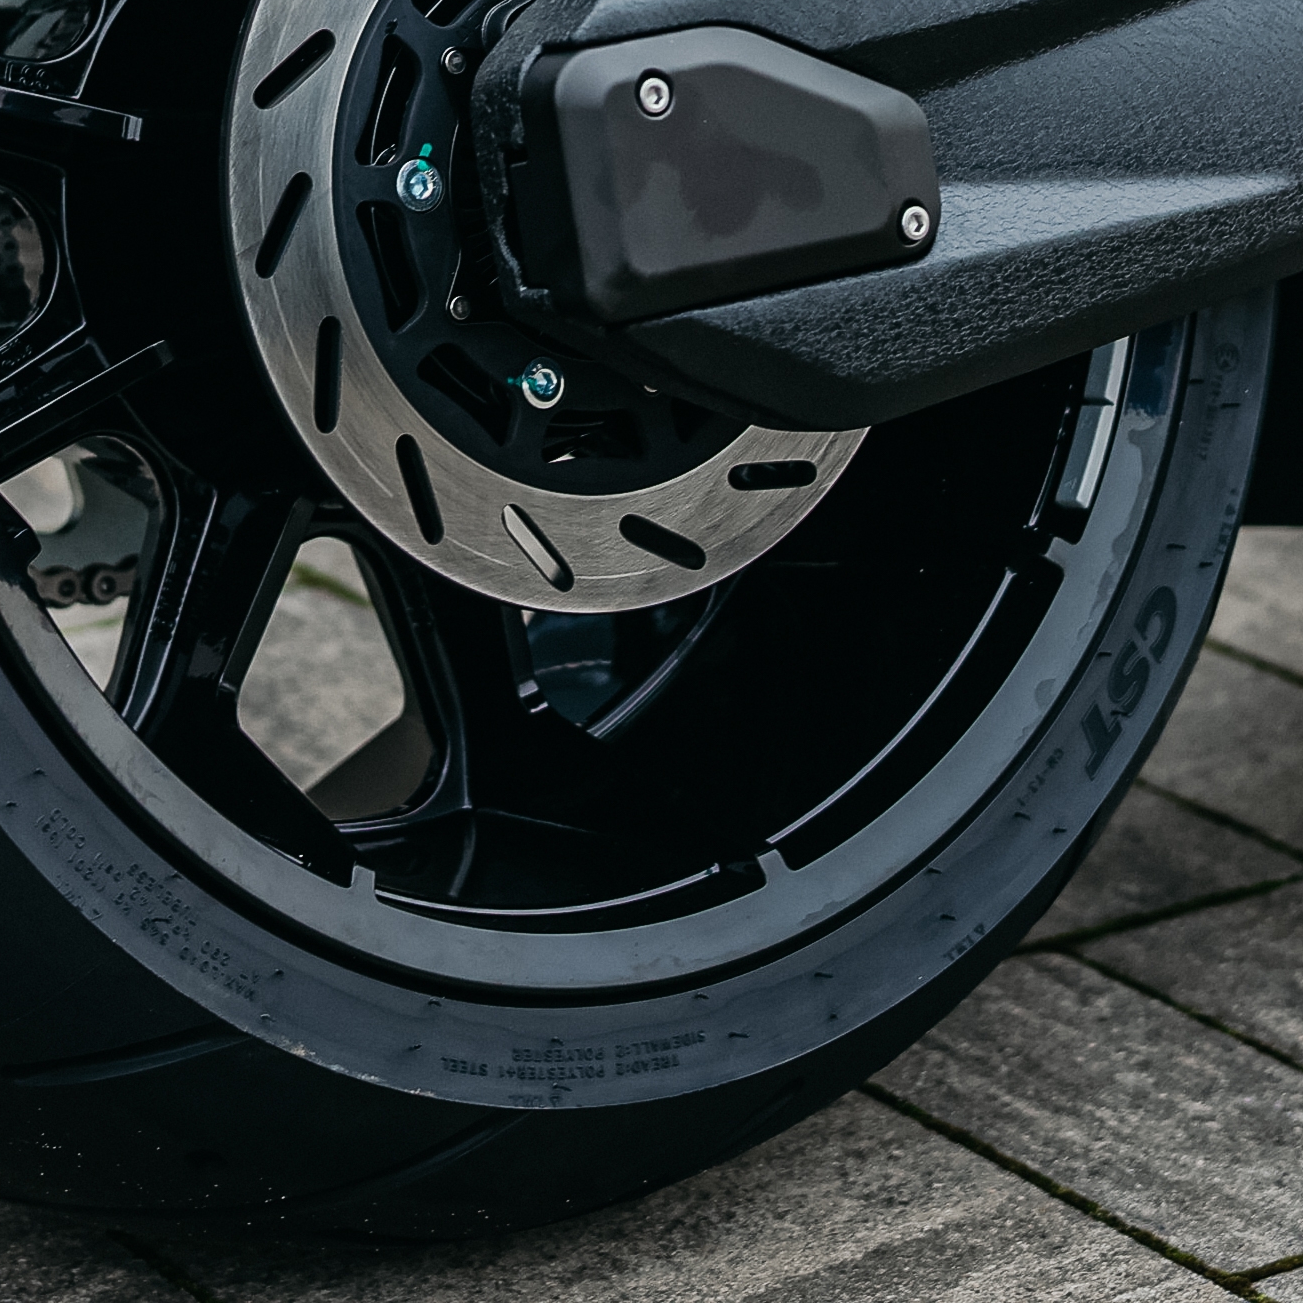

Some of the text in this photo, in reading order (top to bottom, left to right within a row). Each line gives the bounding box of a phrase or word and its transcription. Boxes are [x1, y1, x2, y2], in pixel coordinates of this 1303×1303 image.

[1080, 585, 1179, 781] CST
[511, 1046, 604, 1062] POLYESTER
[439, 1056, 488, 1076] STEEL
